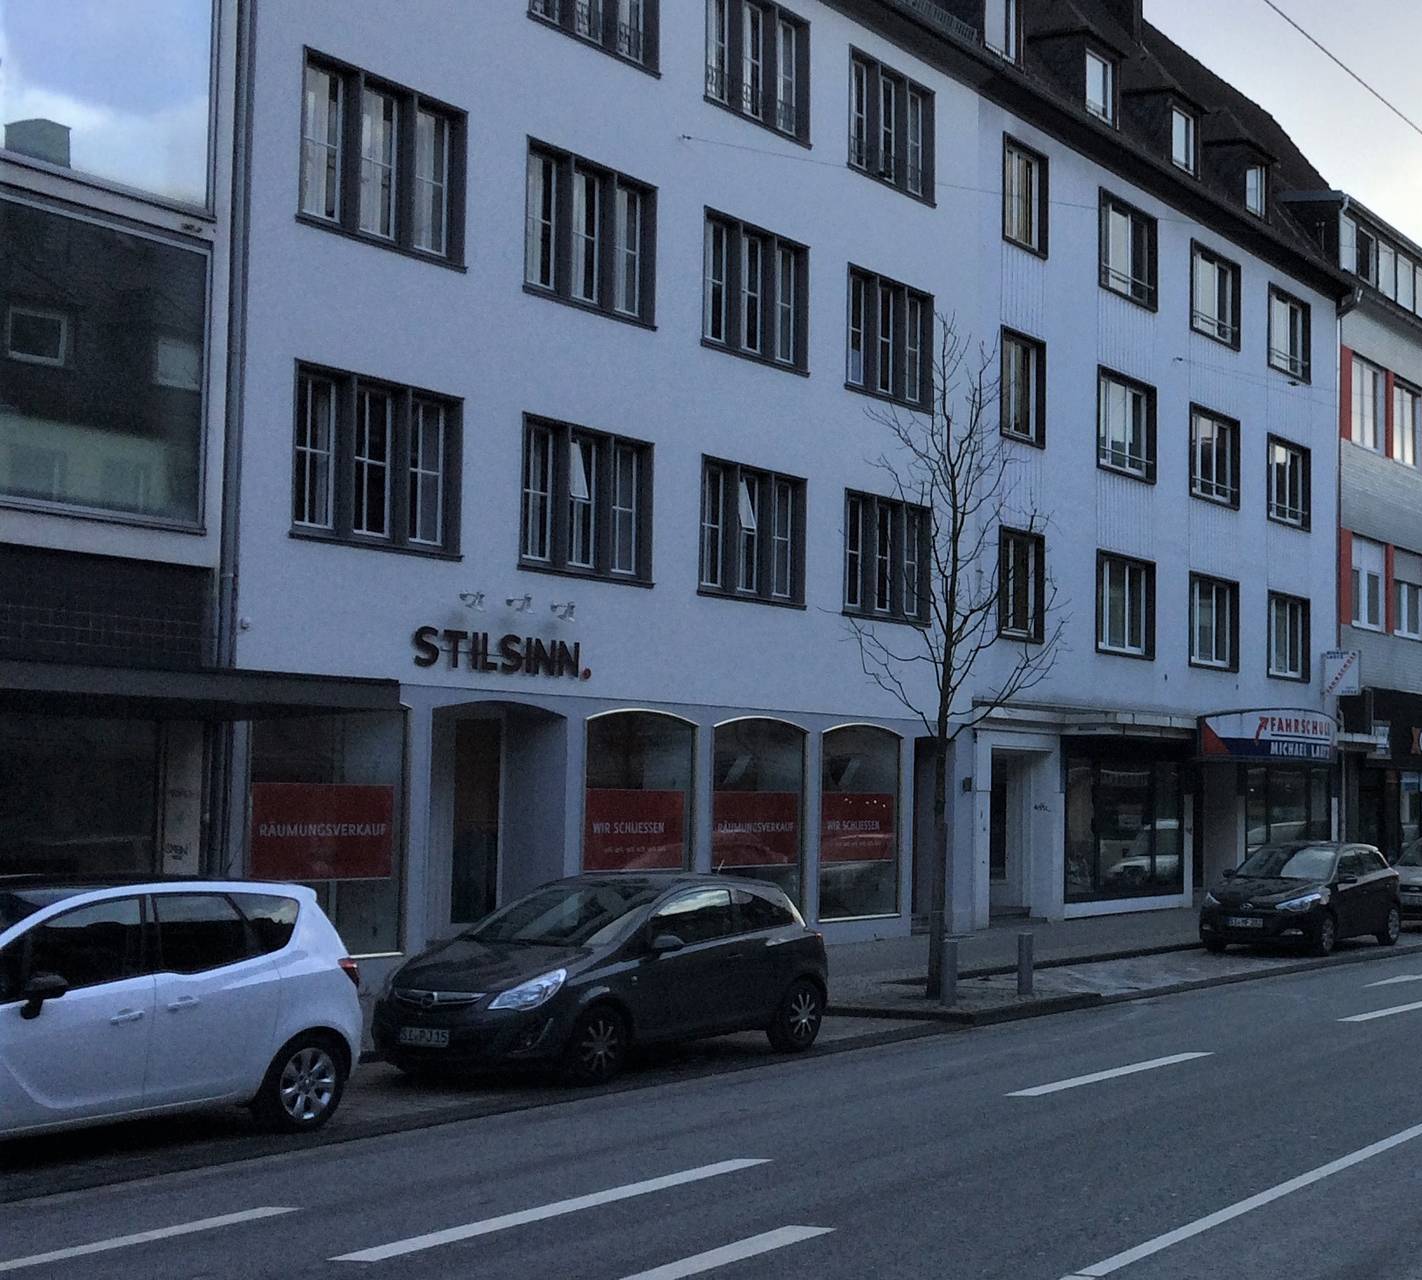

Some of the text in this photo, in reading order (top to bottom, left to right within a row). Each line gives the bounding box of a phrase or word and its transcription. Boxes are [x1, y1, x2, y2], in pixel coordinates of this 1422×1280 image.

[1270, 741, 1308, 757] MICHAEL
[259, 819, 387, 837] RÄUMUNGSVERKAUF
[592, 821, 665, 834] WIR SCHLIESSEN
